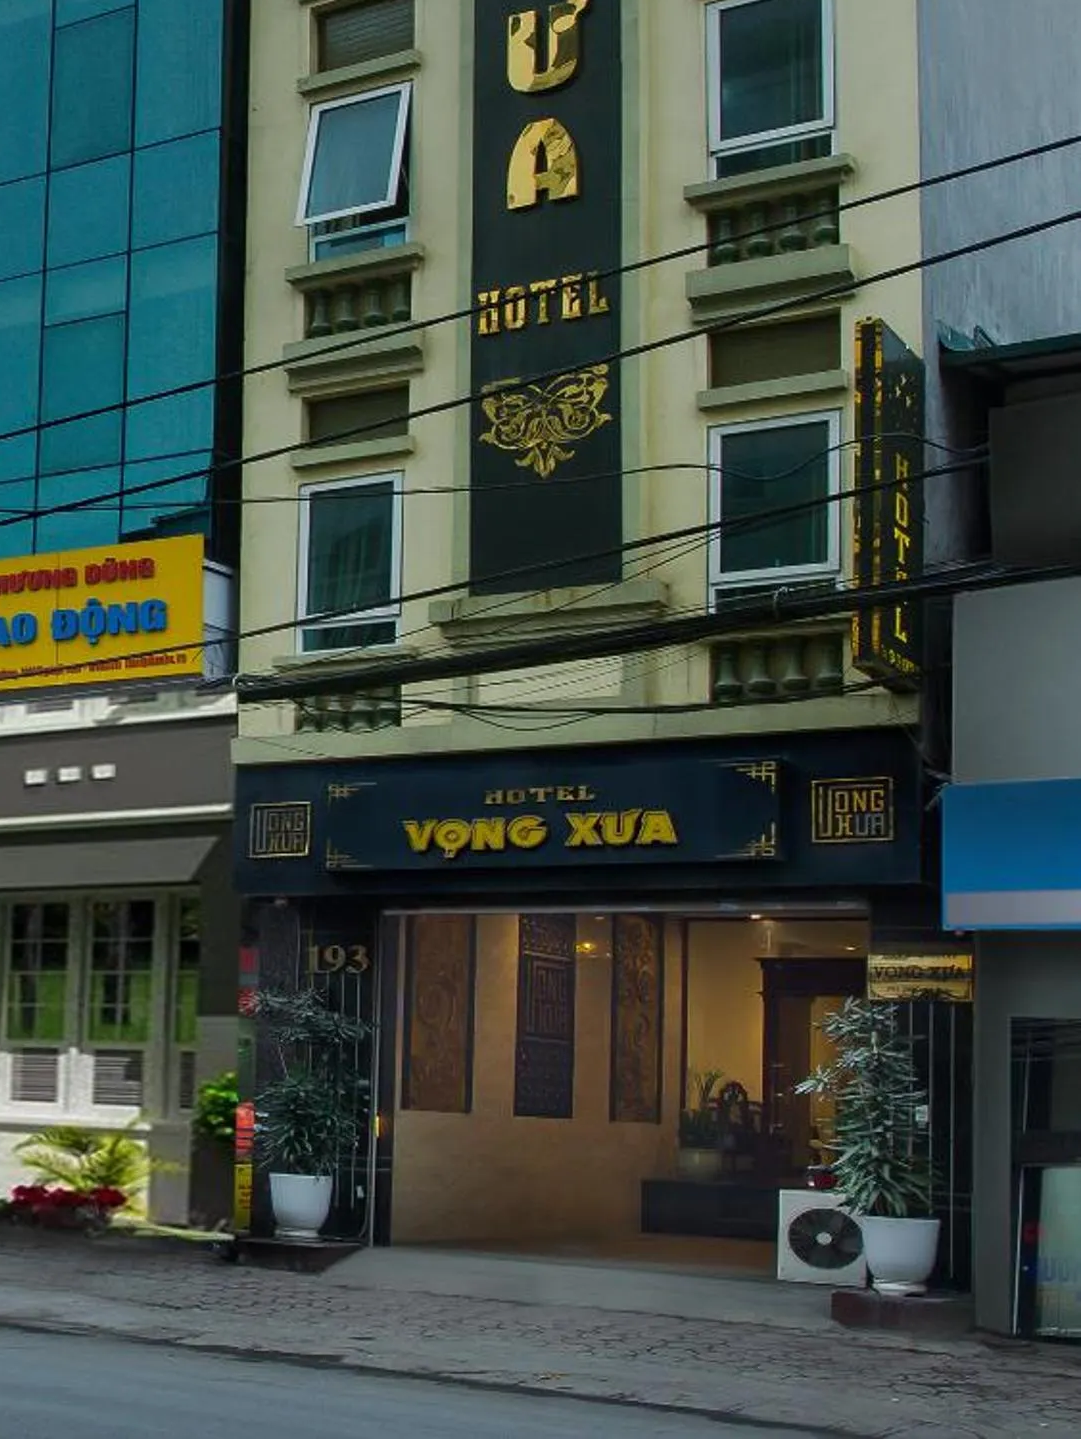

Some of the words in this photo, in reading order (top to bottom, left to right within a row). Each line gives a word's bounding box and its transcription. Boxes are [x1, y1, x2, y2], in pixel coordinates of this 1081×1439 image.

[477, 271, 610, 336] HOTEL
[51, 598, 167, 646] ĐỘNG
[484, 785, 596, 805] HOTEL
[402, 814, 548, 858] VỌNG
[564, 808, 679, 847] XƯA
[305, 944, 372, 974] 193
